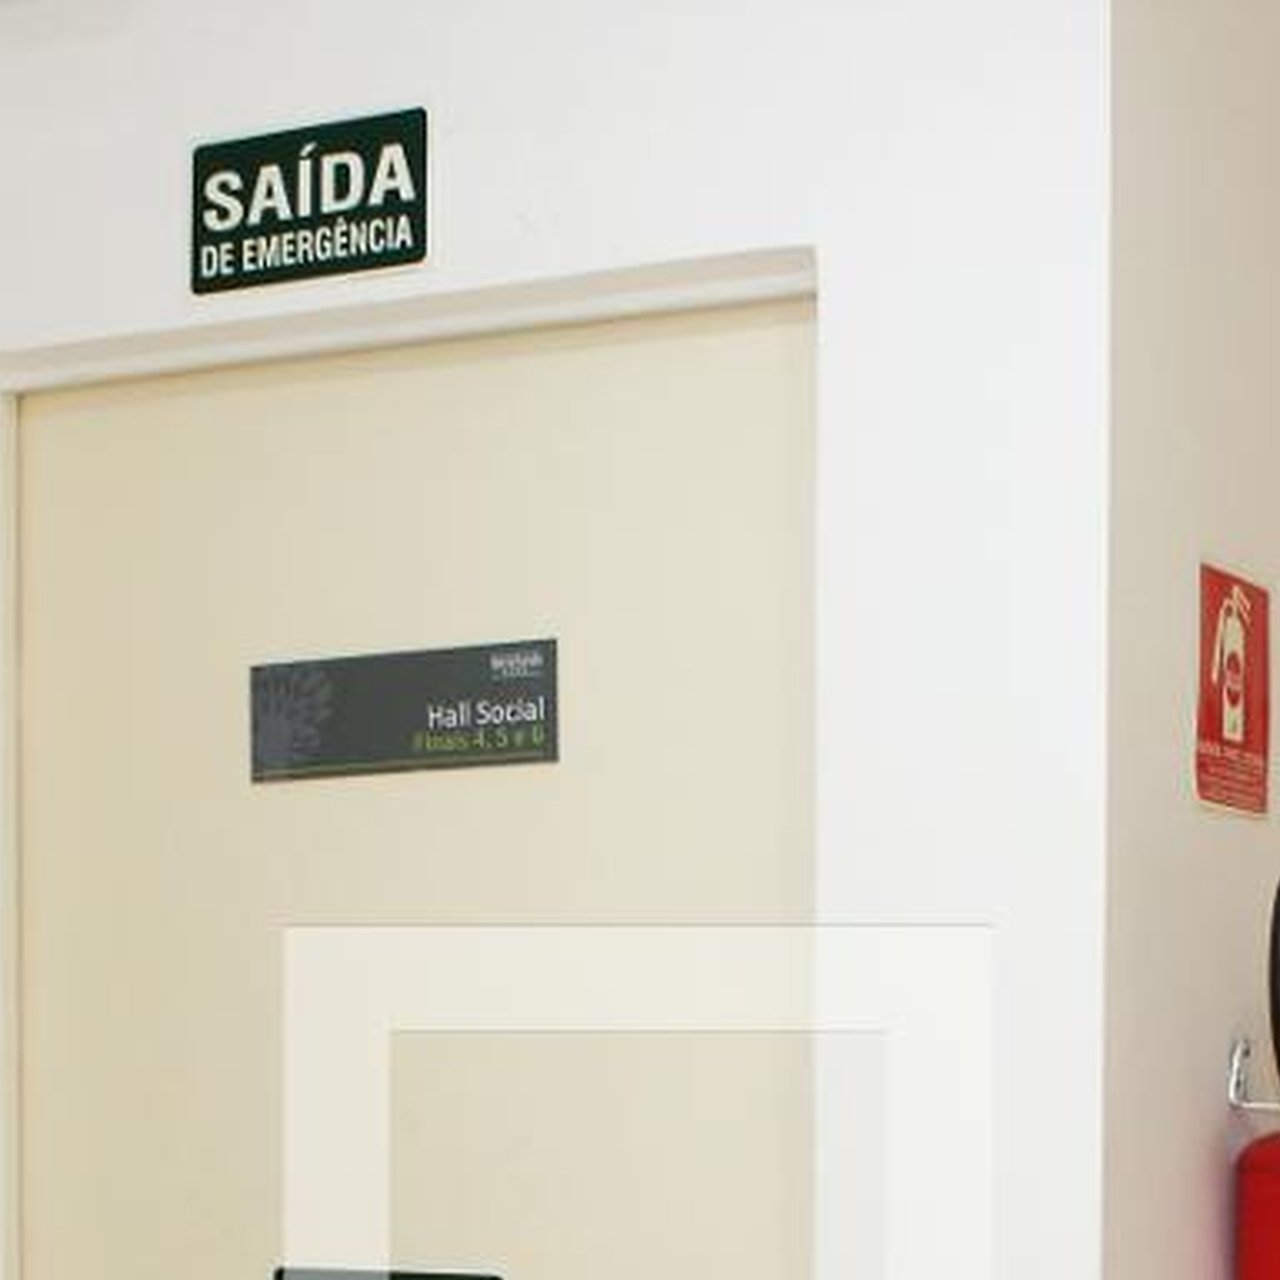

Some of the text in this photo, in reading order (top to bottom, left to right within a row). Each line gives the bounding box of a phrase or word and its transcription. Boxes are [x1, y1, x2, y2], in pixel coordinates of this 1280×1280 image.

[202, 142, 416, 232] SAÍDA
[200, 215, 414, 278] DE EMERGÊNCIA
[427, 696, 545, 730] Hall Social
